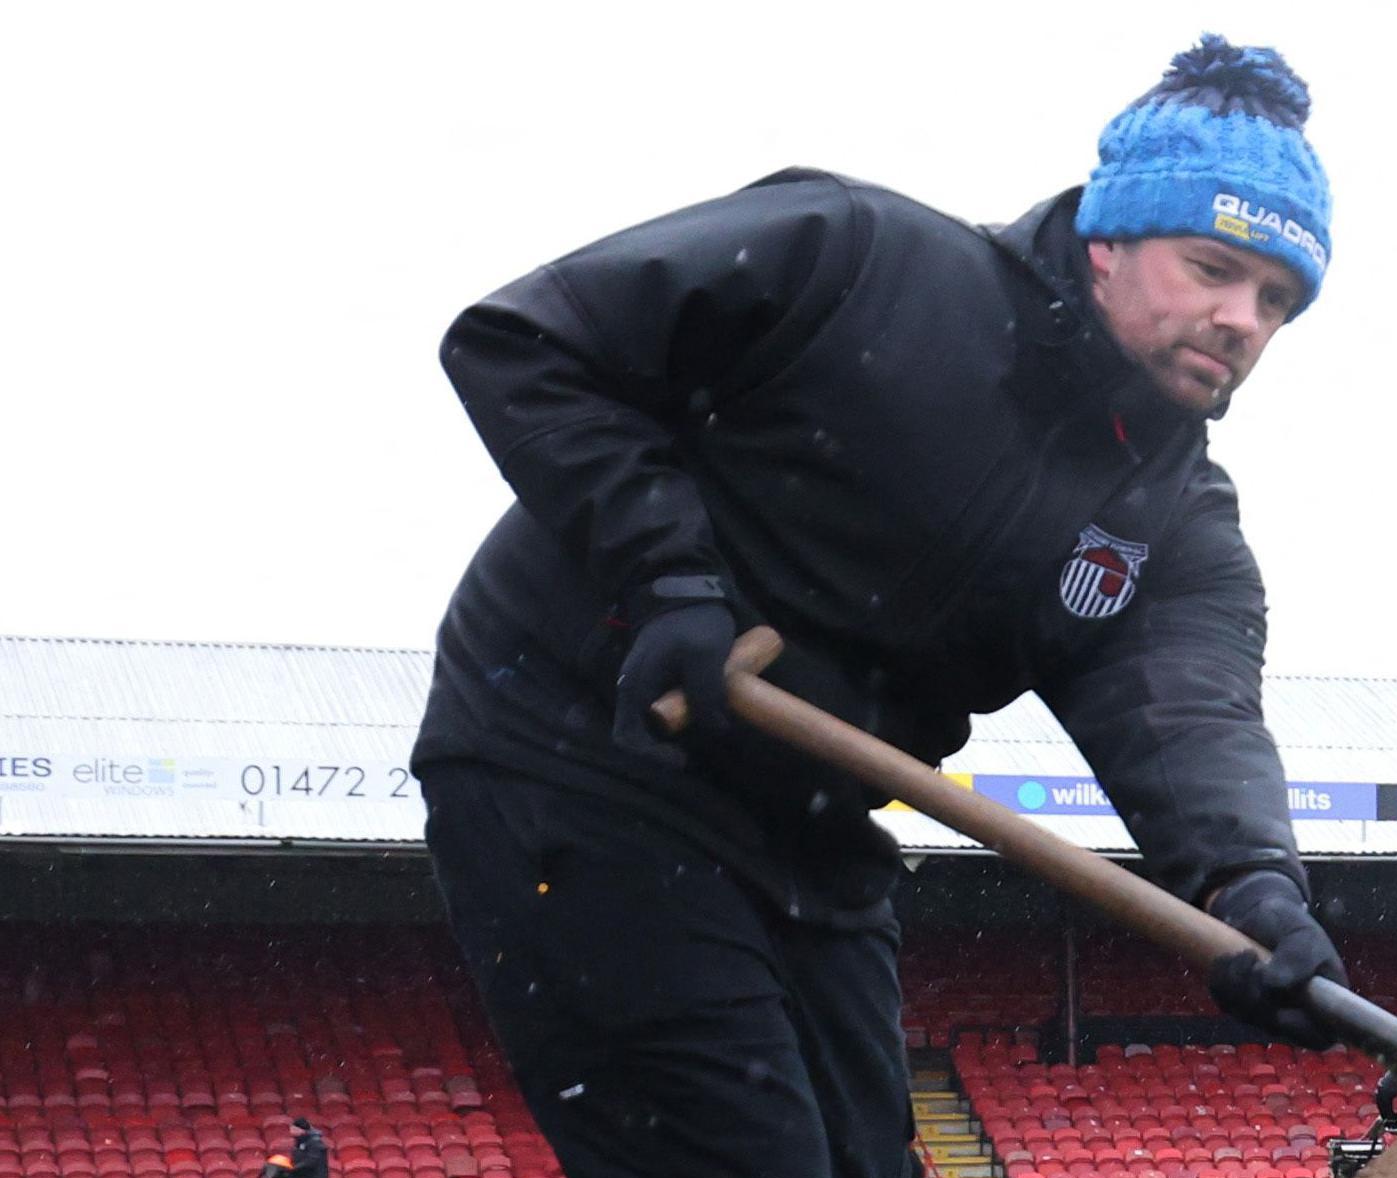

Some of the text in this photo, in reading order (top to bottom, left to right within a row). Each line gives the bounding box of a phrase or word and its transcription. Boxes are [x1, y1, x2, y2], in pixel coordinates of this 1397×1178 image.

[72, 757, 144, 784] elite
[240, 764, 367, 797] 01472
[103, 785, 176, 797] WINDOWS
